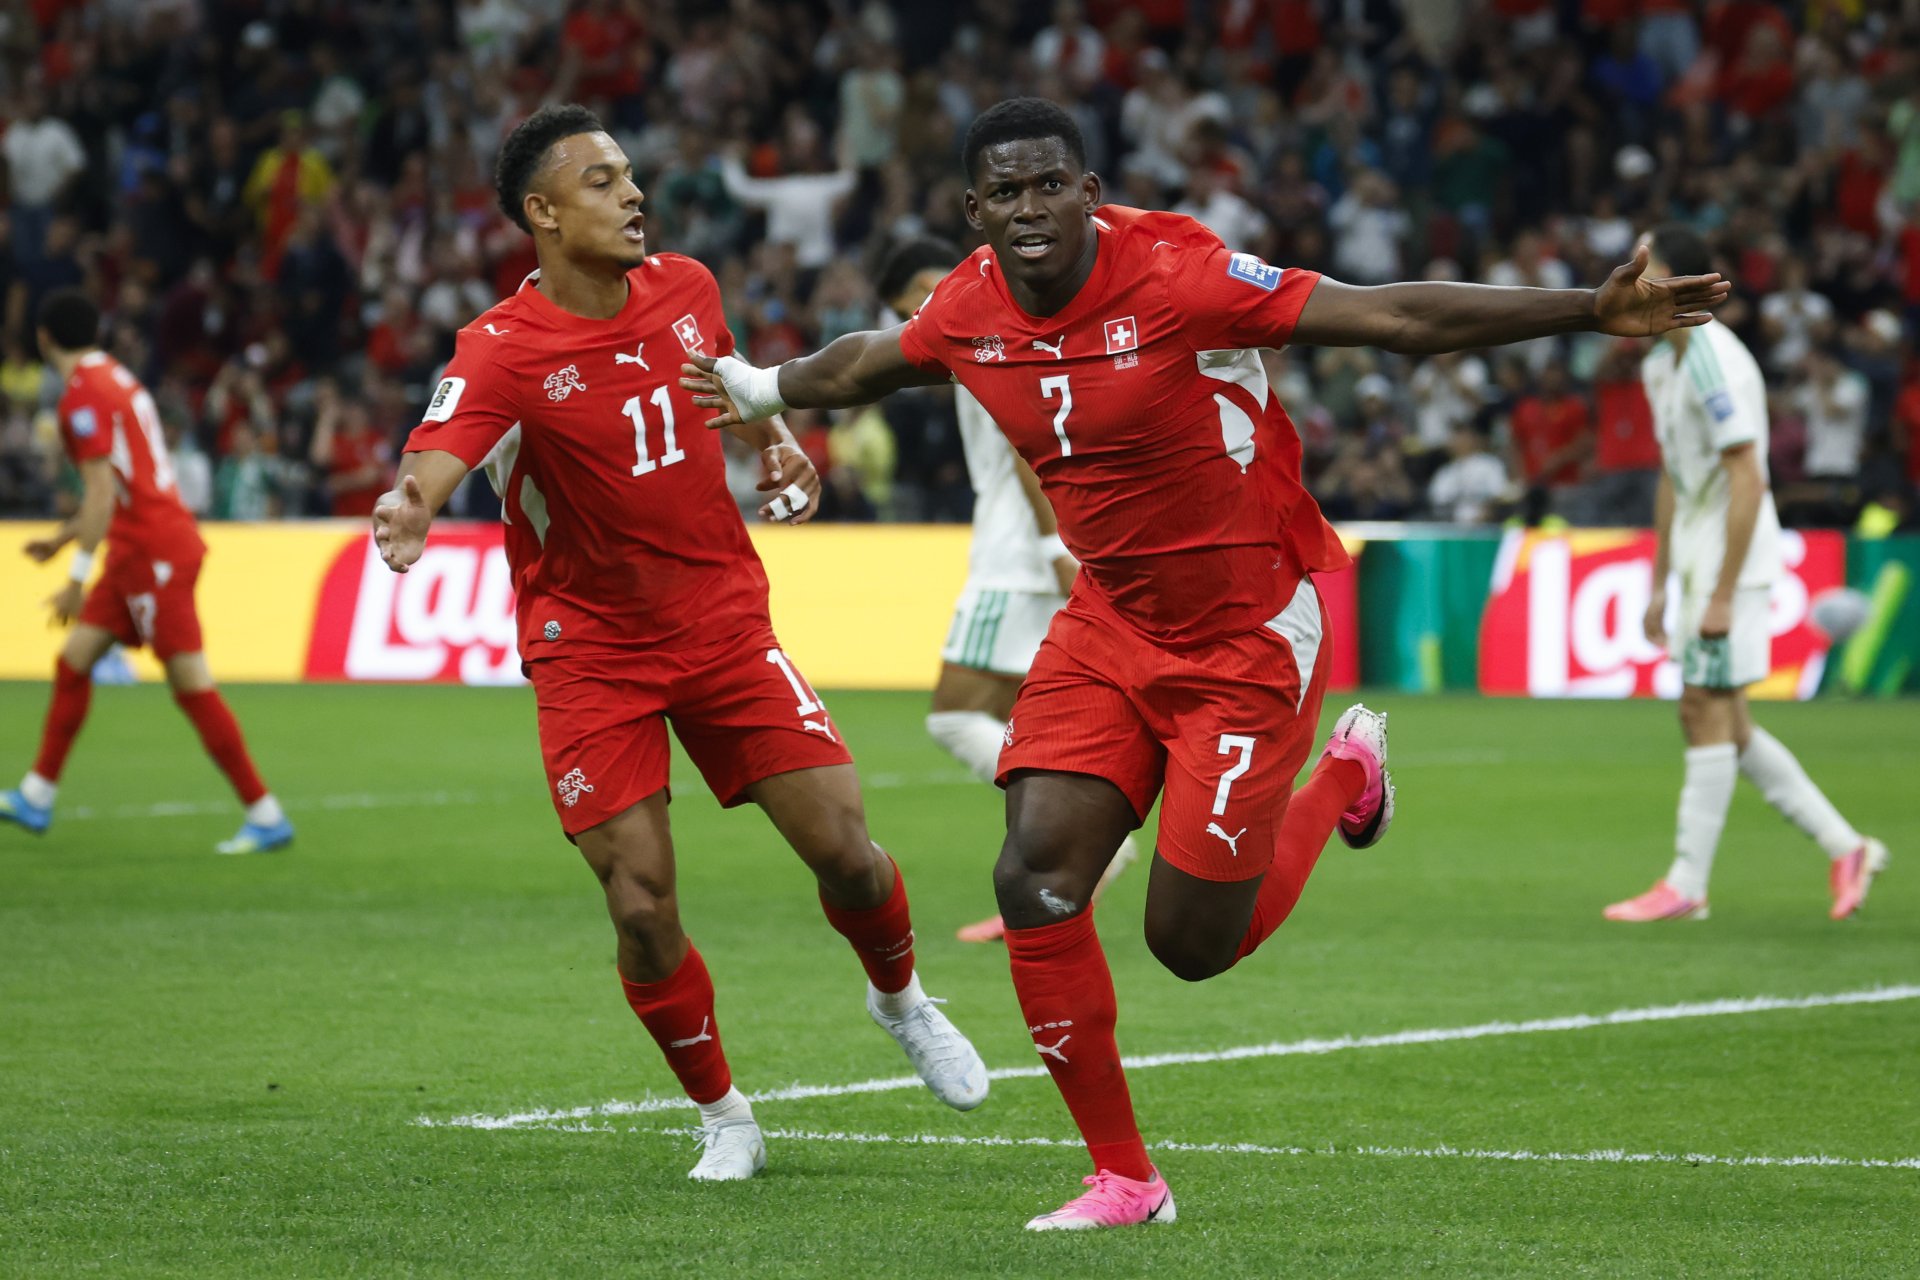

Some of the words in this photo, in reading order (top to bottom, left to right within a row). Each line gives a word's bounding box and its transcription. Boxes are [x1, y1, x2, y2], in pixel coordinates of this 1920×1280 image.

[621, 384, 686, 477] 11
[1039, 374, 1073, 457] 7
[1212, 733, 1257, 816] 7
